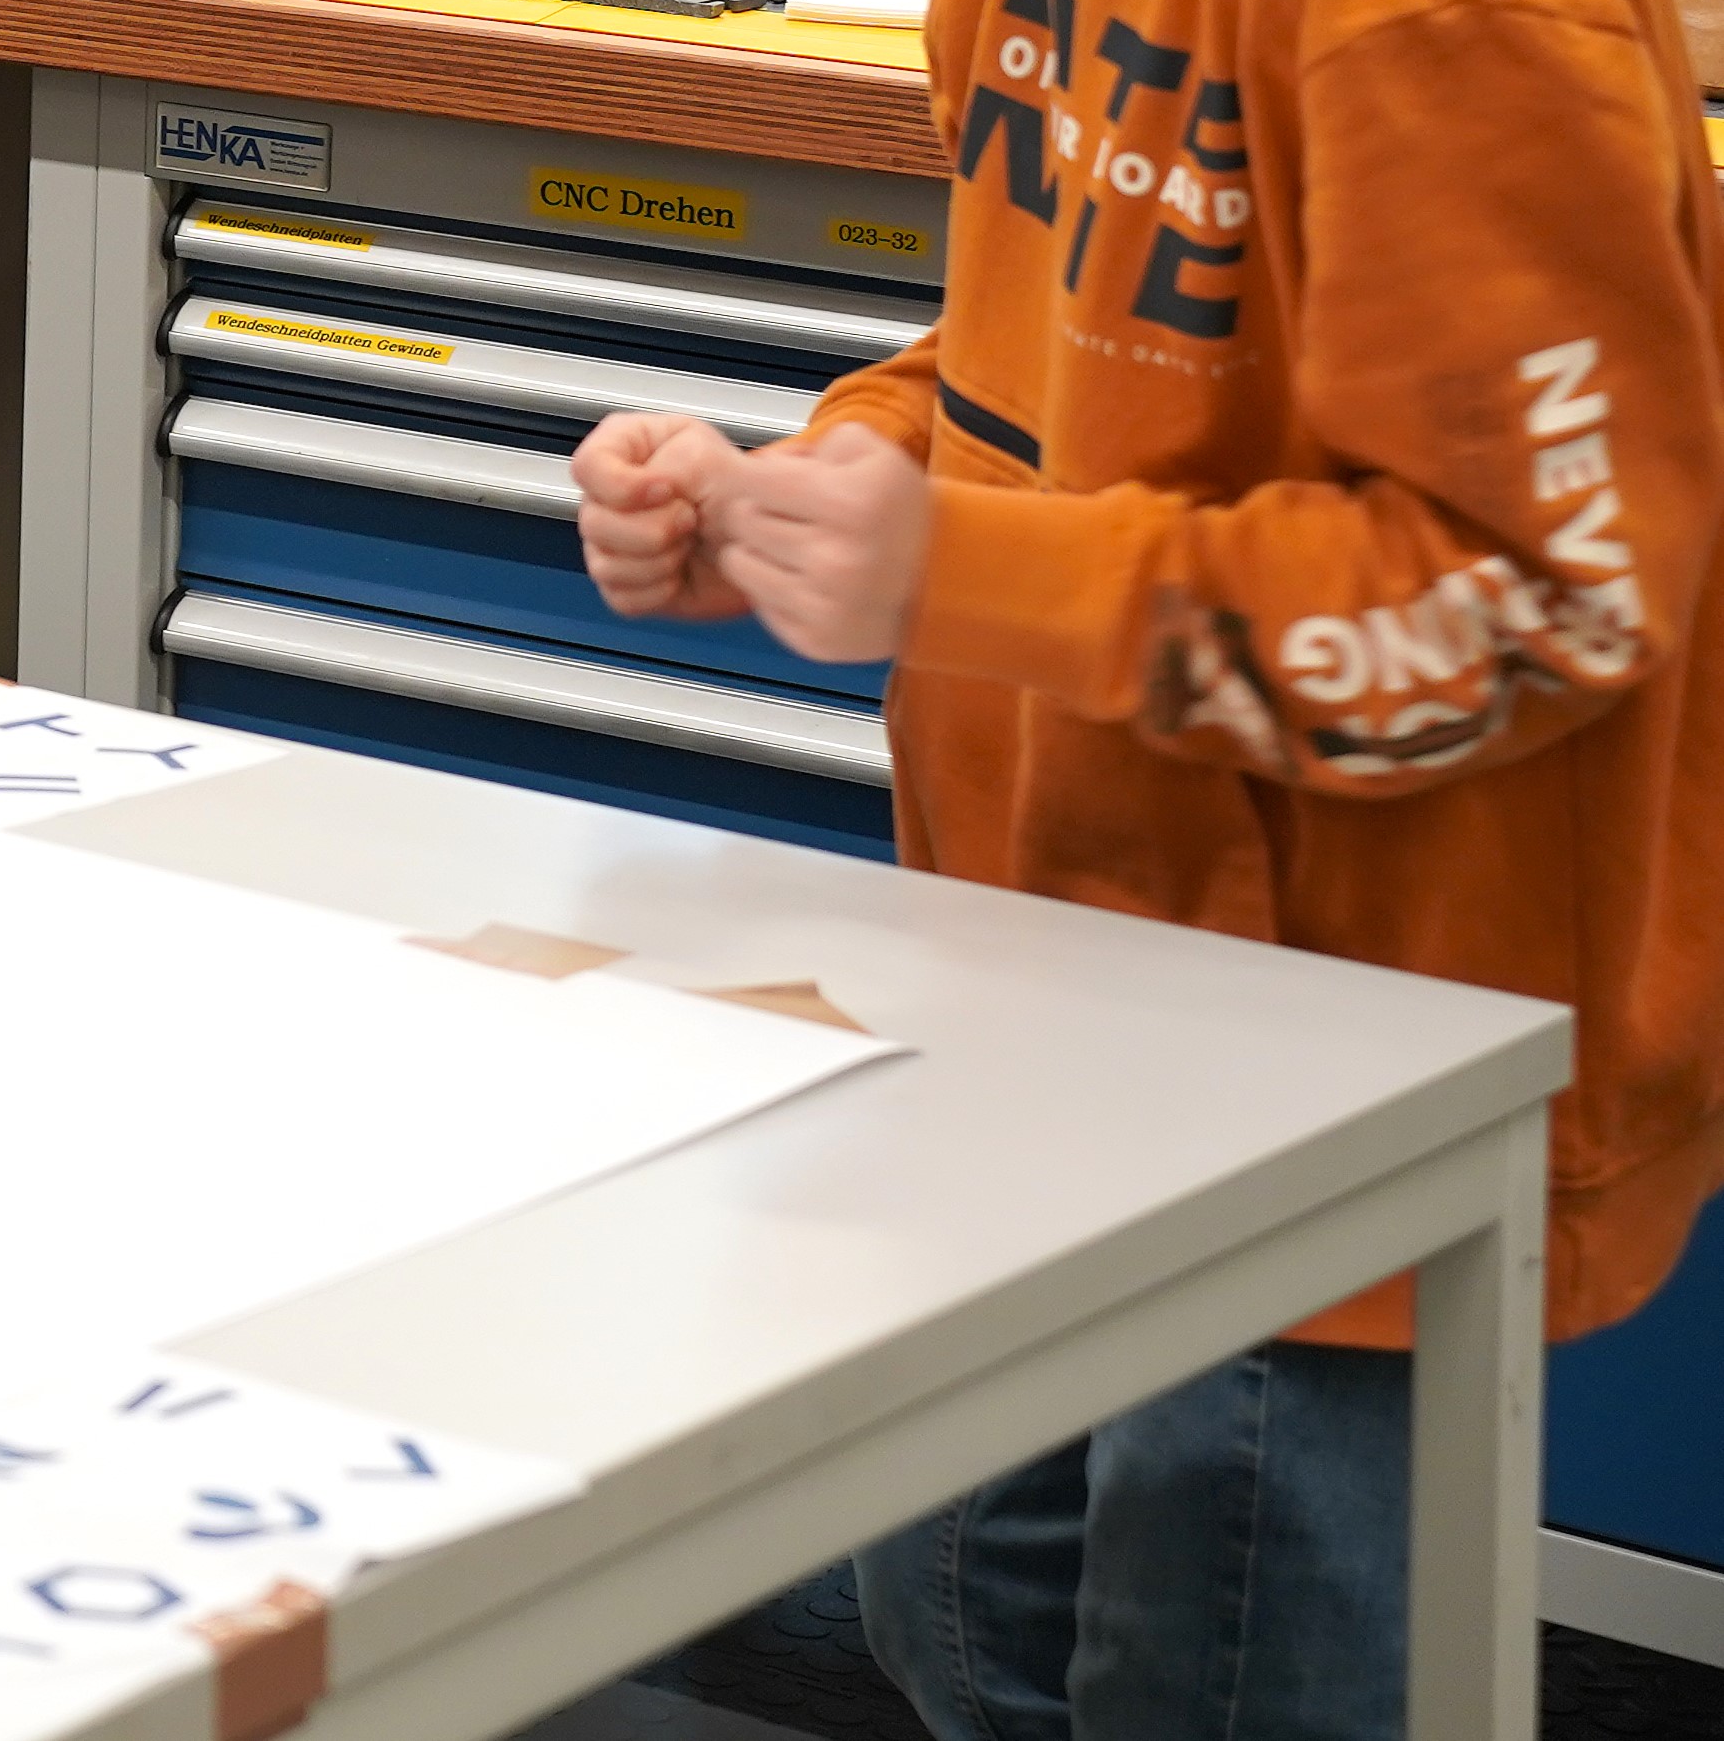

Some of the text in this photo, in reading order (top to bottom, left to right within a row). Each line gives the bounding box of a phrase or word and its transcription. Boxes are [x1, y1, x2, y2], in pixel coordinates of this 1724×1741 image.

[160, 115, 266, 170] HENKA
[540, 180, 736, 229] CNC Drehen
[207, 213, 363, 247] Wendeschneidplatten
[217, 314, 442, 359] Wendeschneidplatten Gewinde
